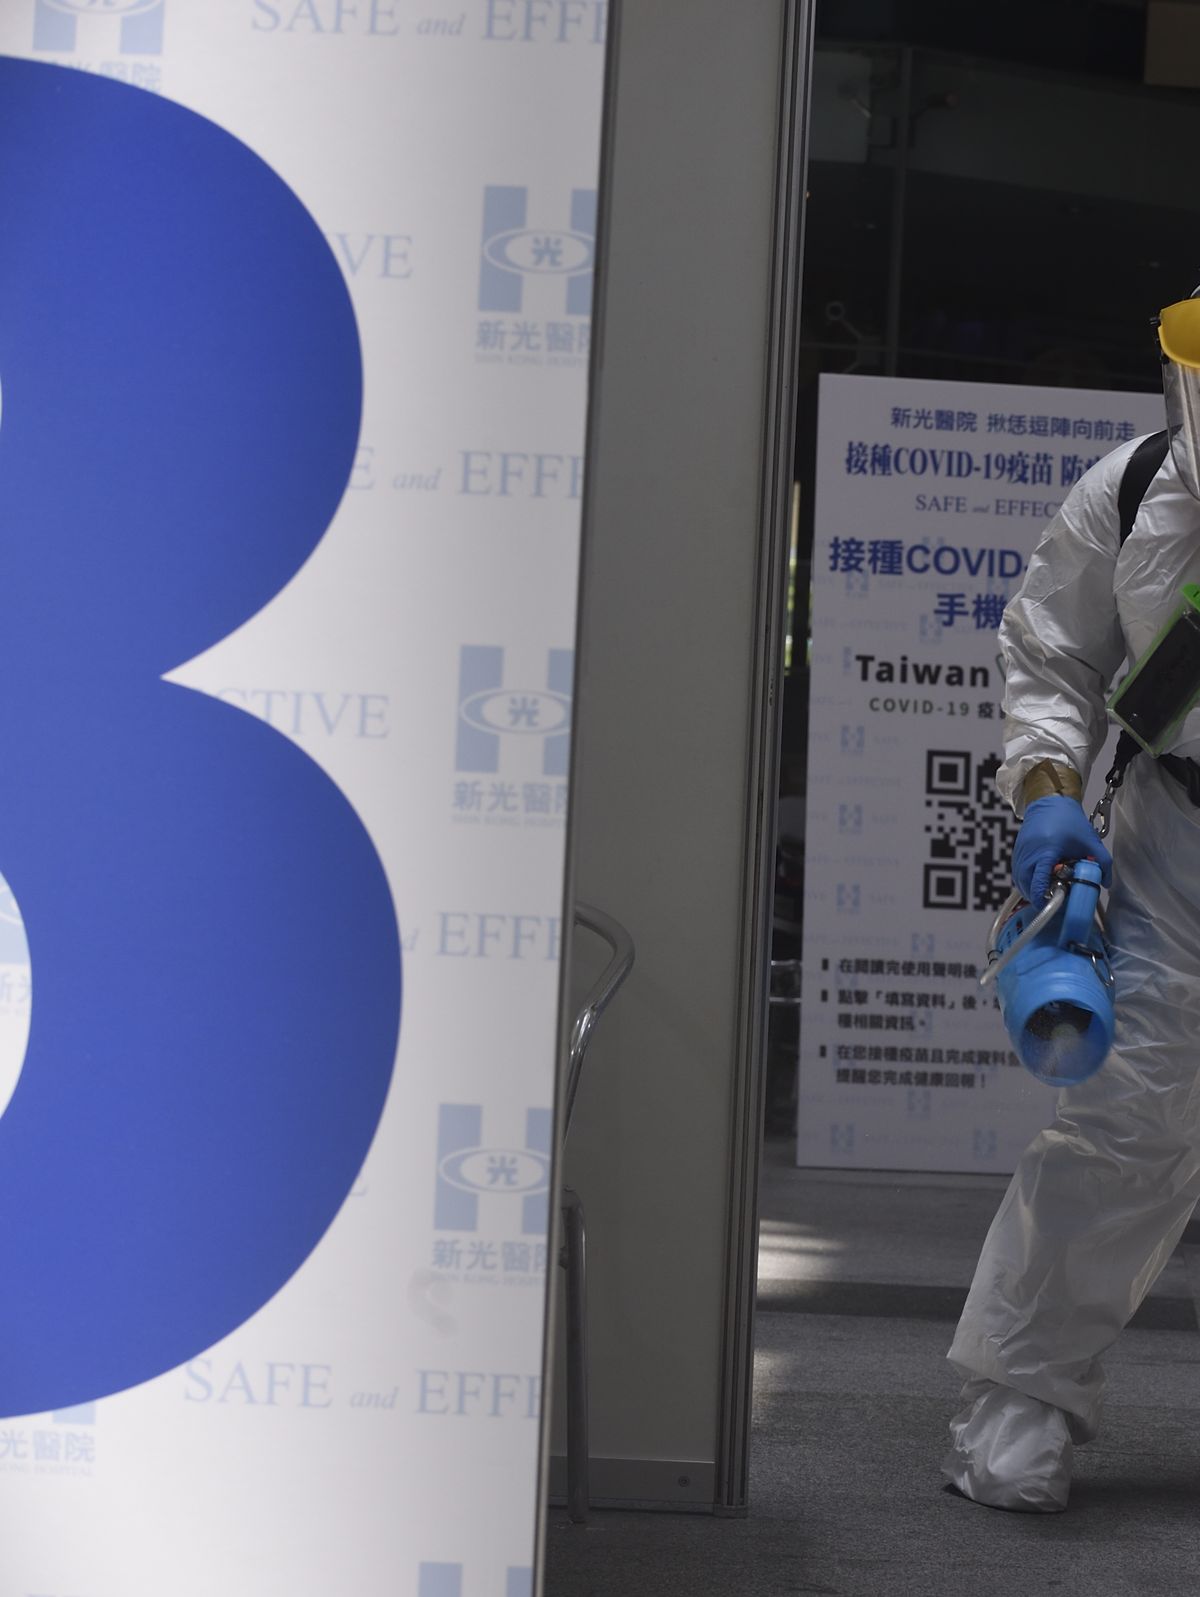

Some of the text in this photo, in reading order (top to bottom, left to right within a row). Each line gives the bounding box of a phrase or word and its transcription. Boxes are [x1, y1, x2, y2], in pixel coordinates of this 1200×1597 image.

[416, 14, 466, 37] and
[891, 407, 977, 432] 新光醫院
[845, 441, 1101, 487] 接種COVID-19疫苗 防
[392, 467, 442, 491] and
[915, 494, 967, 514] SAFE
[856, 654, 989, 688] Taiwan
[869, 697, 970, 717] COVID-19
[184, 1359, 333, 1408] SAFE
[349, 1384, 399, 1411] and
